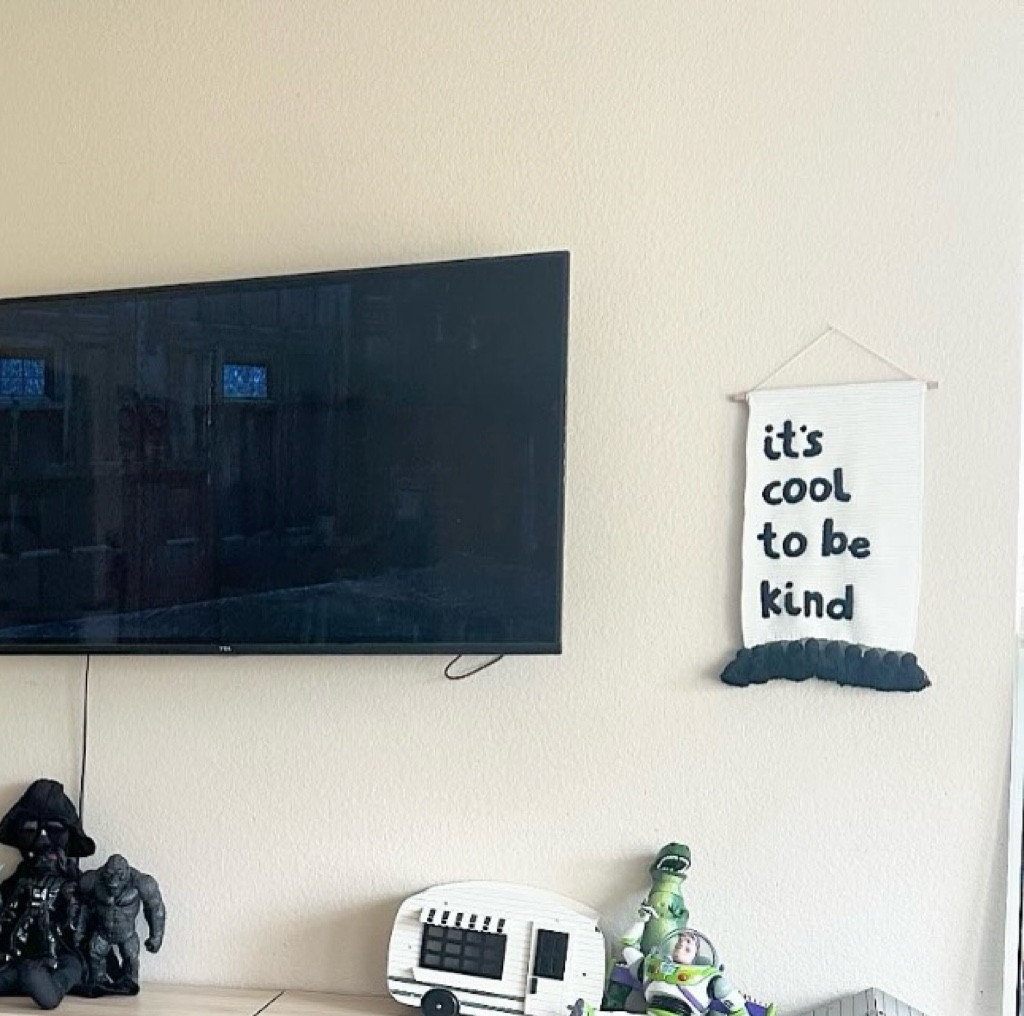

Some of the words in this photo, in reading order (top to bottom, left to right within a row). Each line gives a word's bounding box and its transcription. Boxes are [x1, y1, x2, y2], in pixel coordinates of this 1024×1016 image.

[762, 419, 824, 461] it's
[761, 467, 852, 506] cool
[756, 521, 808, 560] to
[820, 517, 871, 560] be
[759, 579, 855, 621] kind
